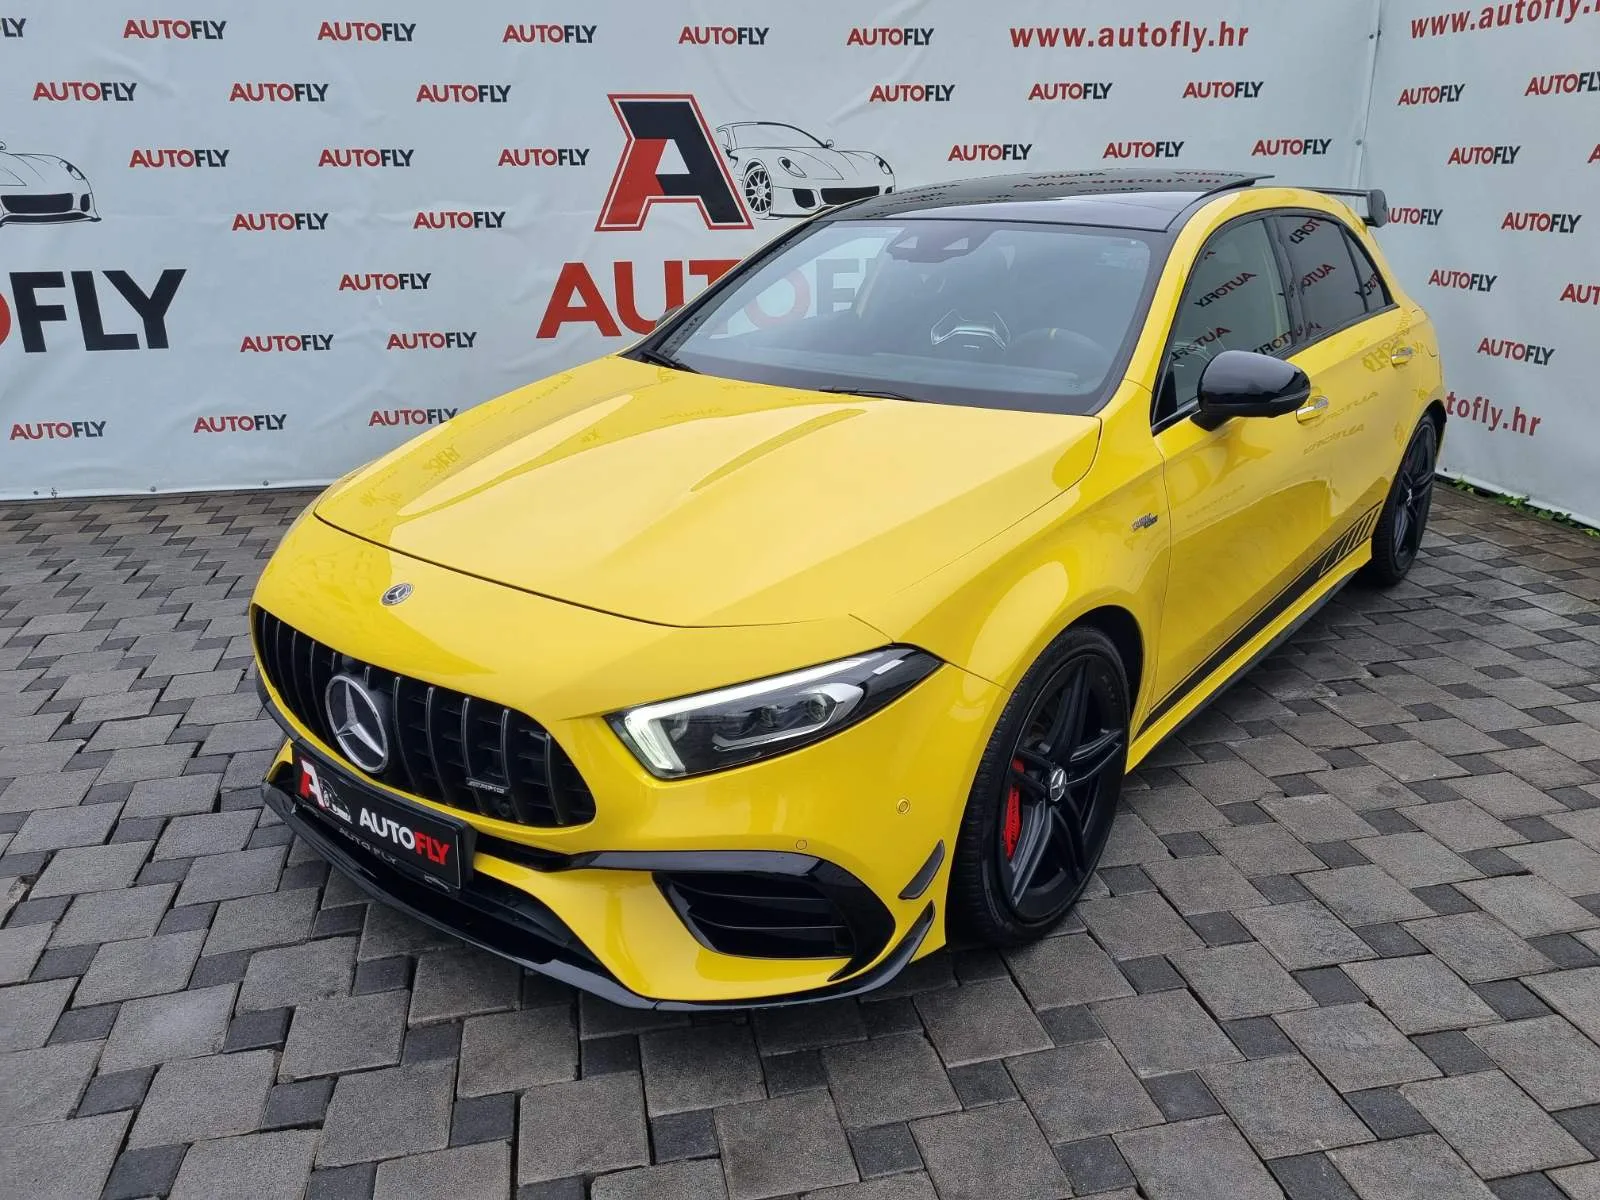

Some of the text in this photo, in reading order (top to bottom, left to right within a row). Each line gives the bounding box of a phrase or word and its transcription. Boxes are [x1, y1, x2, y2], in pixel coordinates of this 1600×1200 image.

[123, 19, 227, 40] AUTOFLY
[1412, 0, 1600, 39] www.autofly.
[317, 21, 417, 42] AUTOFLY
[502, 24, 597, 44] AUTOFLY
[678, 26, 770, 46] AUTOFLY
[846, 27, 935, 46] AUTOFLY
[1009, 20, 1249, 53] www.autofly.hr
[33, 81, 137, 102] AUTOFLY
[229, 83, 329, 102] AUTOFLY
[416, 84, 512, 103] AUTOFLY
[869, 84, 956, 103] AUTOFLY
[1028, 82, 1113, 101] AUTOFLY
[1182, 81, 1264, 99] AUTOFLY
[1524, 71, 1600, 97] AUTOFL
[1397, 83, 1466, 106] AUTOFLY
[947, 143, 1033, 162] AUTOFLY
[1102, 141, 1185, 159] AUTOFLY
[1251, 138, 1333, 156] AUTOFLY
[1447, 145, 1521, 165] AUTOFLY
[129, 149, 230, 168] AUTOFLY
[318, 148, 415, 168] AUTOFLY
[497, 148, 590, 167] AUTOFLY
[233, 212, 329, 232] AUTOFLY
[413, 211, 506, 229] AUTOFLY
[1500, 211, 1583, 234] AUTOFLY
[338, 272, 432, 291] AUTOFLY
[1428, 269, 1498, 293] AUTOFLY
[0, 268, 187, 353] FLY
[240, 334, 334, 353] AUTOFLY
[386, 331, 478, 350] AUTOFLY
[1476, 337, 1555, 366] AUTOFLY
[9, 420, 107, 441] AUTOFLY
[193, 413, 287, 434] AUTOFLY
[359, 807, 451, 866] AUTOFLY
